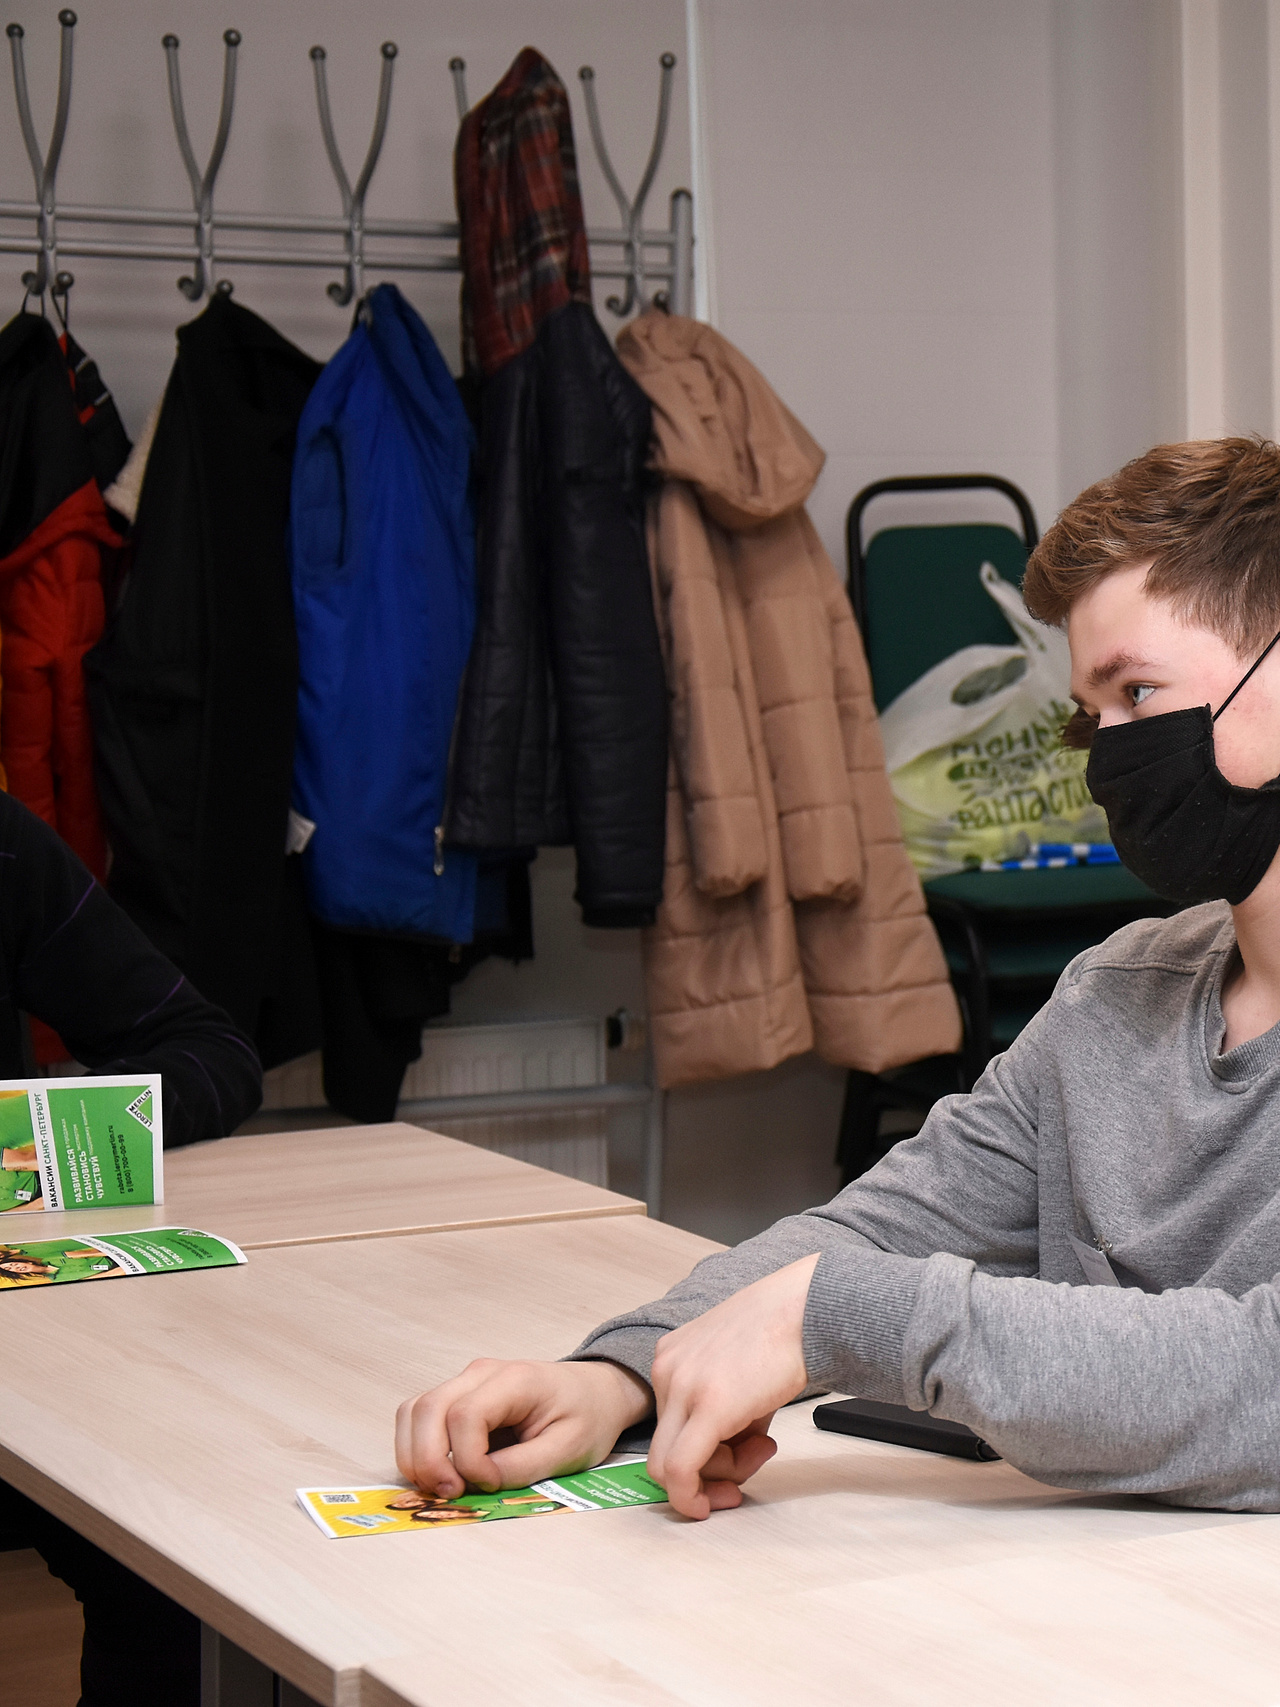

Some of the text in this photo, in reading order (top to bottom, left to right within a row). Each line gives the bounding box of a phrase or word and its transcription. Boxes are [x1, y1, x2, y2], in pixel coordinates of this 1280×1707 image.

[128, 1089, 153, 1128] LEROY MERLIN
[34, 1093, 59, 1208] ВАКАНСИИ САНКТ-ПЕТЕРБУРГ
[108, 1125, 125, 1194] rabota.leroymerlin.ru
[117, 1134, 130, 1169] 700-00-99
[66, 1148, 83, 1203] РАЗВИВАЙСЯ
[78, 1150, 94, 1201] СТАНОВИСЬ
[88, 1155, 104, 1199] ЧУВСТВУЙ
[123, 1169, 134, 1188] (800)
